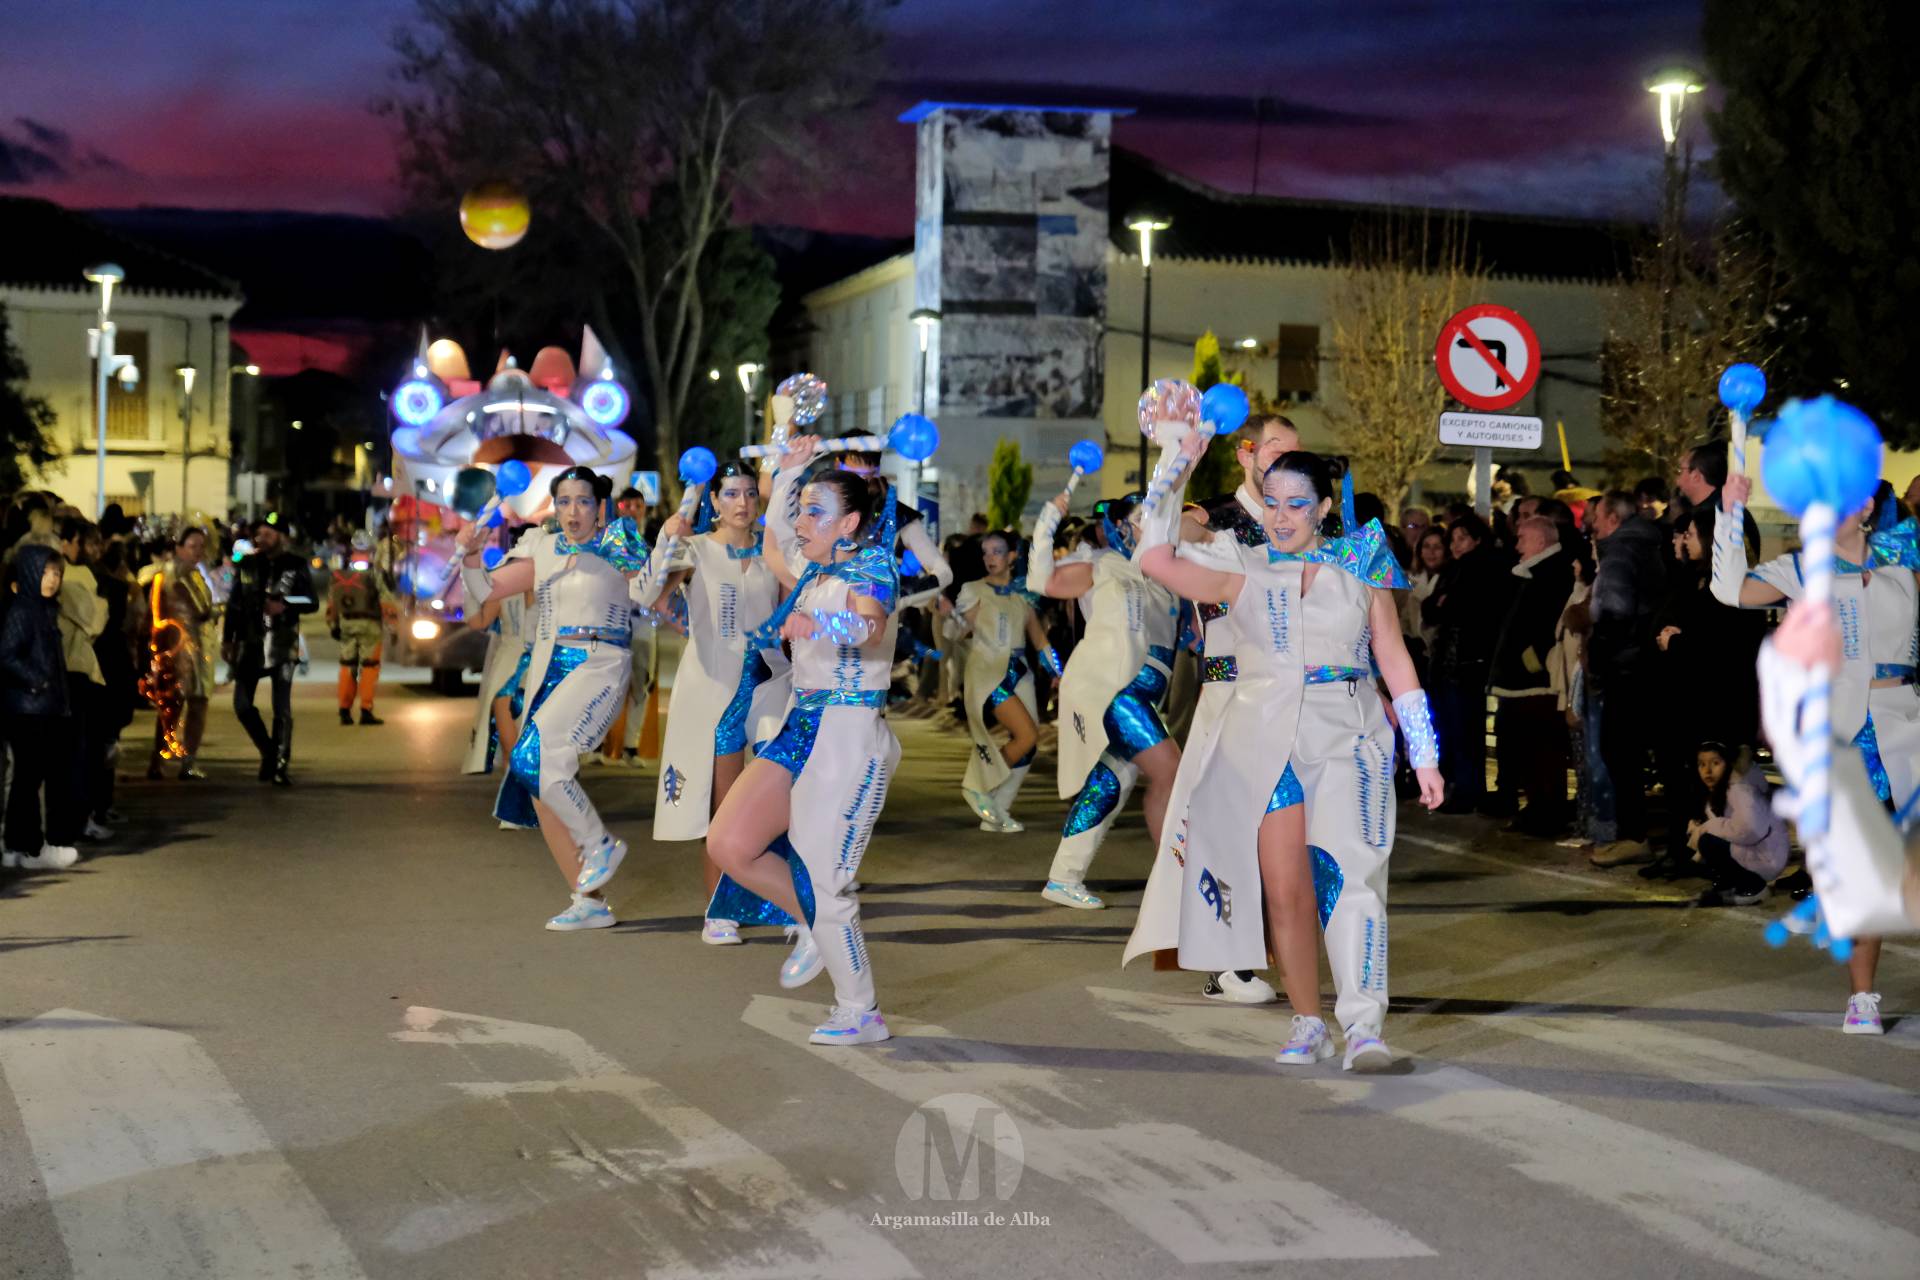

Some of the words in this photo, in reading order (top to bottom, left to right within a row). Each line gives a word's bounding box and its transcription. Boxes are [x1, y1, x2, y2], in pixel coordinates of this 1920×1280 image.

[1442, 418, 1486, 429] EXCEPTO
[1489, 421, 1540, 432] CAMIONES
[1466, 431, 1524, 442] AUTOBUSES
